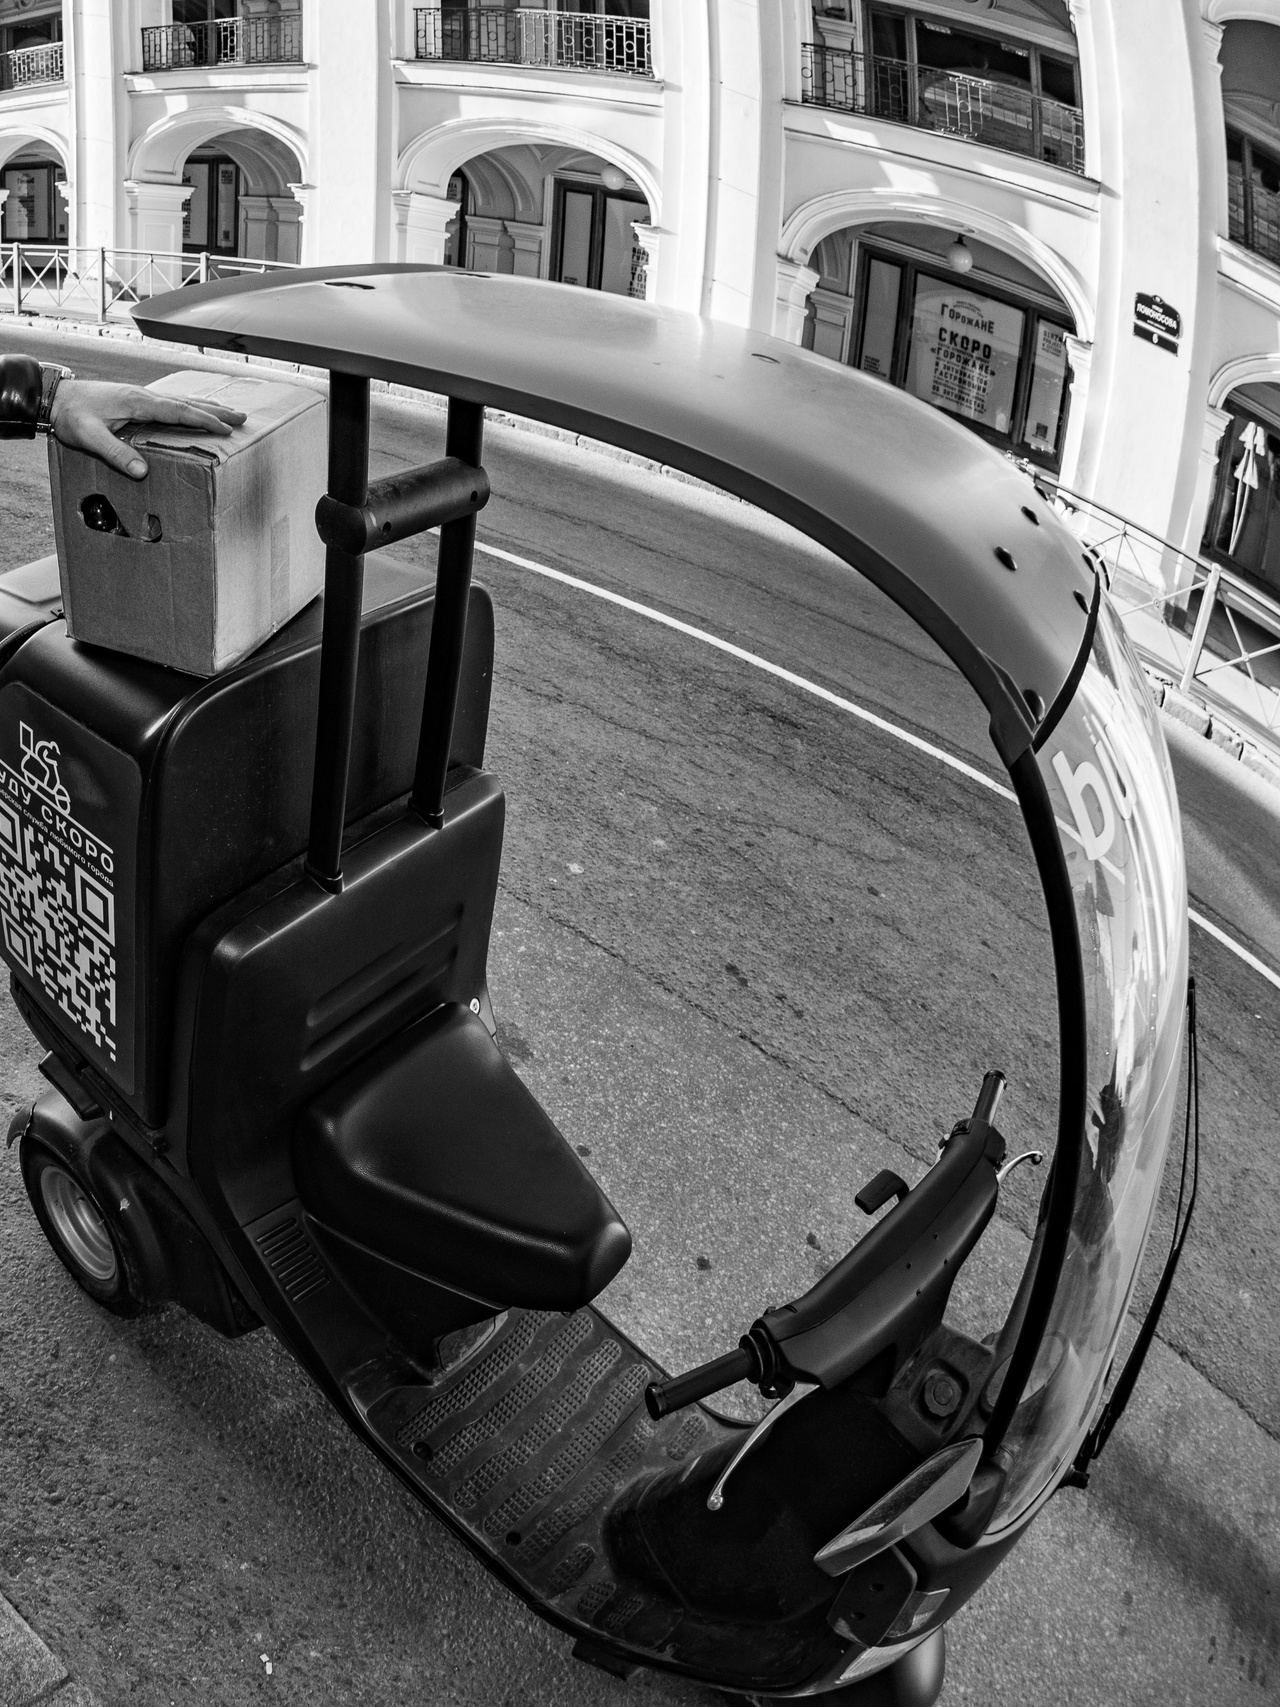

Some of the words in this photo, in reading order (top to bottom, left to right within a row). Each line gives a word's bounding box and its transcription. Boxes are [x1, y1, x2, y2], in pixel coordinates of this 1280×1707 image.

[941, 303, 995, 334] ГОРОЖАНЕ
[1136, 303, 1177, 330] ЛОМОНОСОВА
[938, 327, 991, 359] СКОРО
[23, 809, 48, 833] служба
[49, 831, 86, 863] любимого
[87, 859, 114, 888] города
[41, 805, 114, 873] СКОРО
